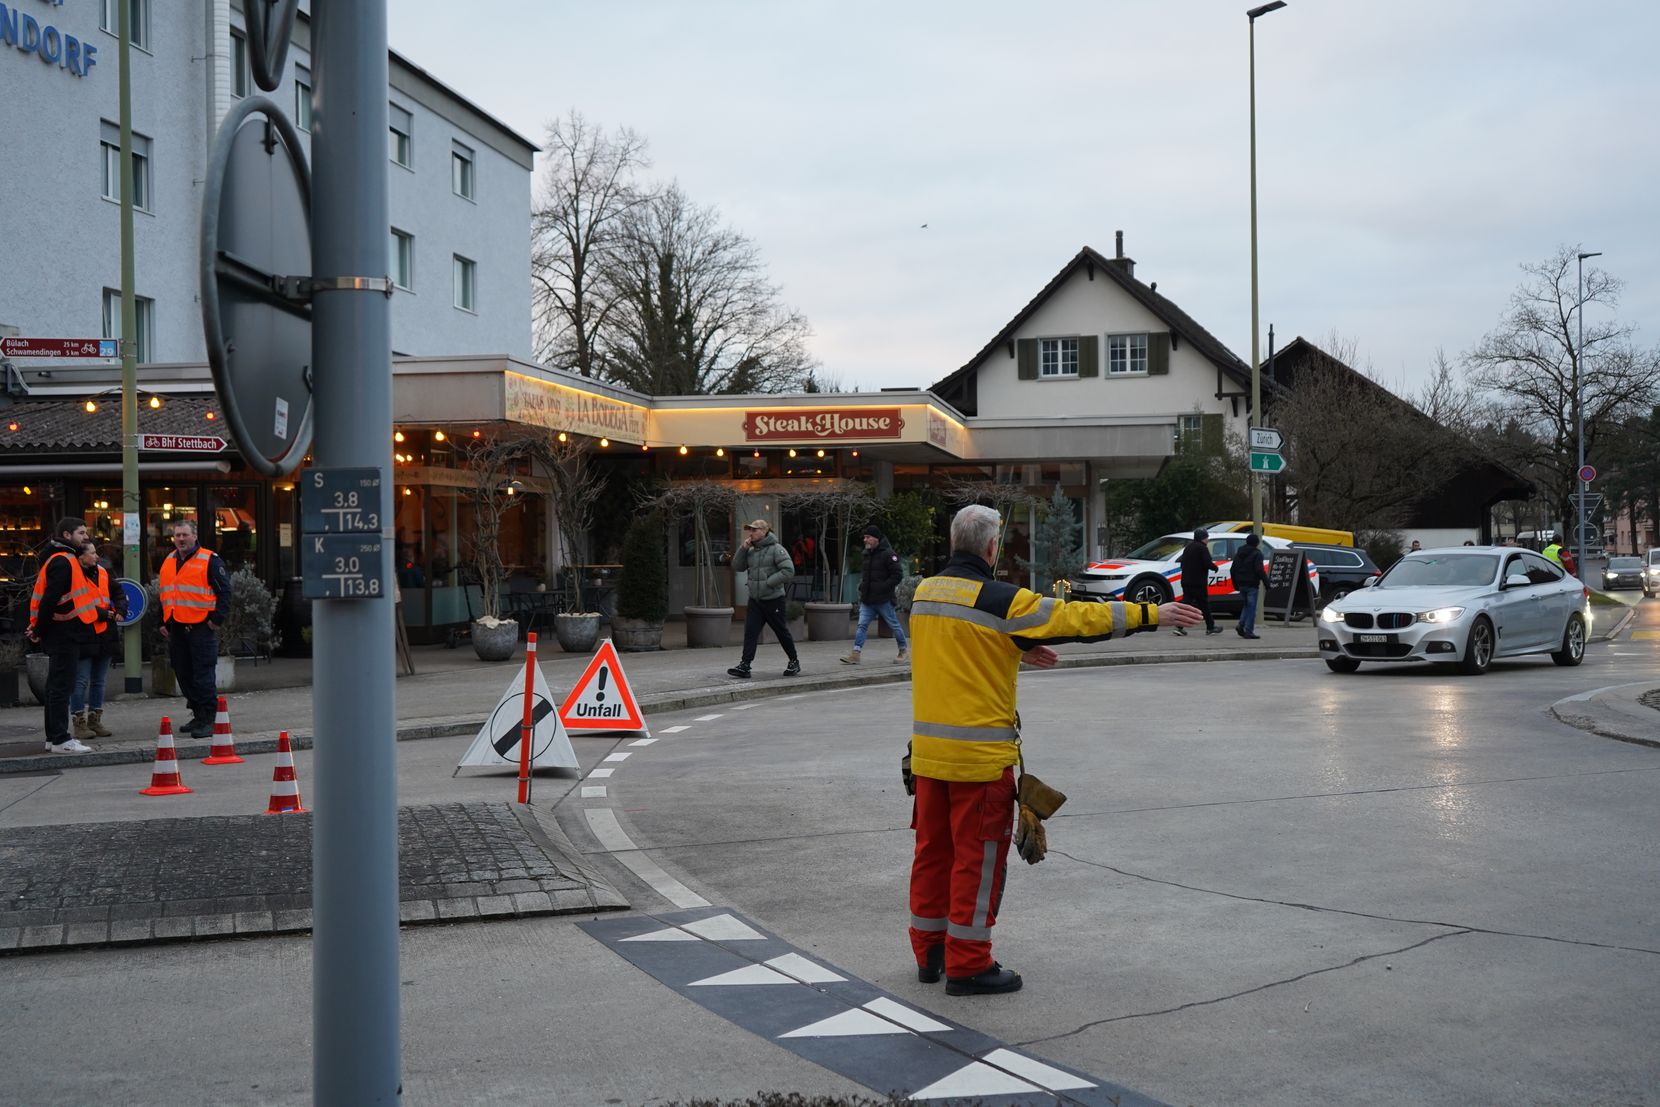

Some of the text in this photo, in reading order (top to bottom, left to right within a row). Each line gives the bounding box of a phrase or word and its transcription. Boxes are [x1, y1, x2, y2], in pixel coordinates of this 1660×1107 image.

[6, 339, 29, 347] Bülach
[6, 348, 62, 358] Schwamendingen
[100, 347, 115, 356] 29
[161, 437, 217, 449] Bhf Stettbach
[1256, 432, 1274, 445] Zürich
[314, 472, 324, 488] S
[334, 491, 358, 507] 3,8
[345, 513, 378, 530] 14,3
[314, 537, 325, 554] K
[335, 557, 360, 573] 3,0
[346, 578, 379, 595] 13,8
[576, 703, 622, 718] Unfall
